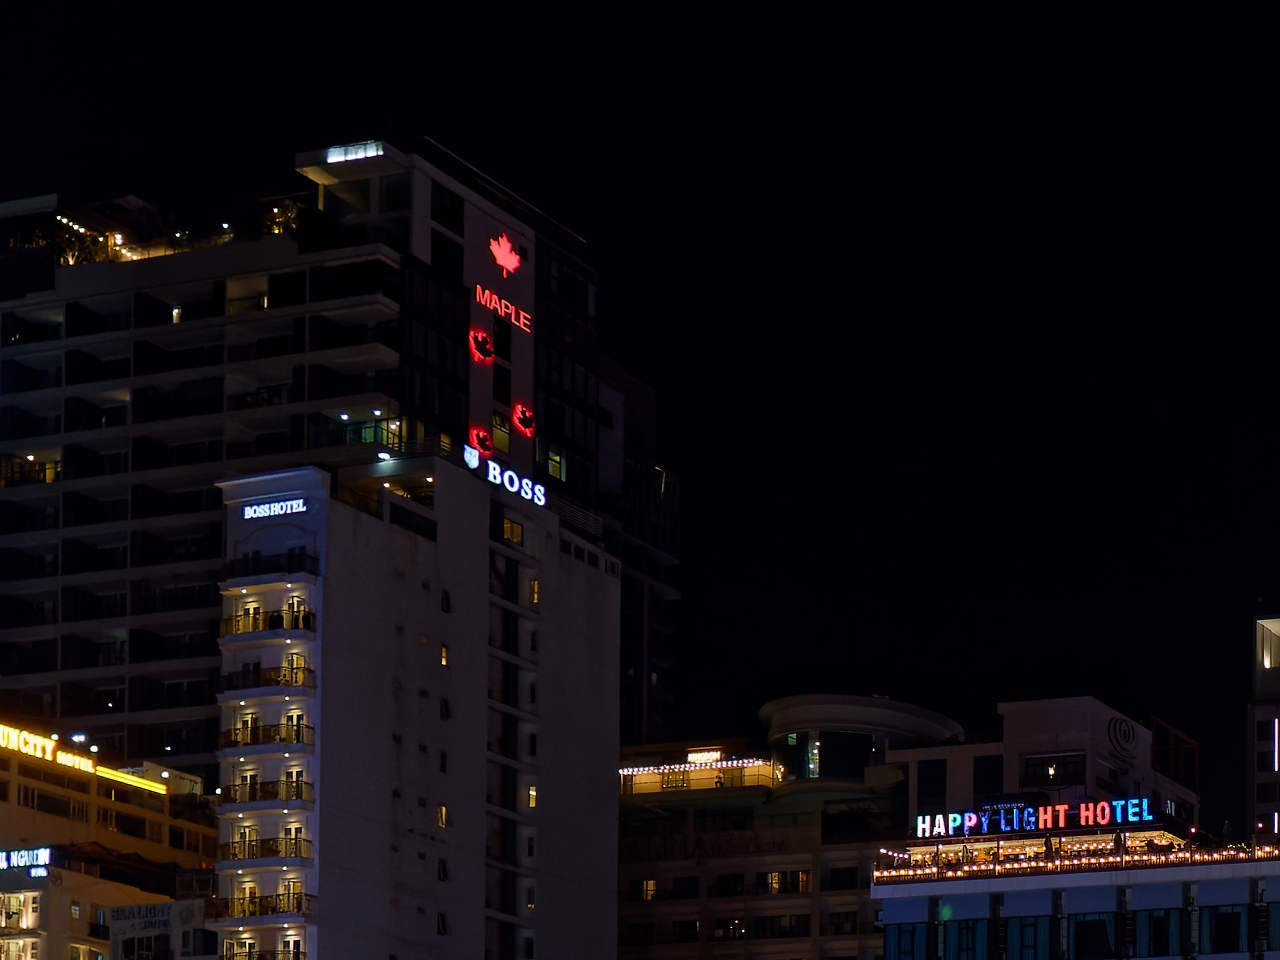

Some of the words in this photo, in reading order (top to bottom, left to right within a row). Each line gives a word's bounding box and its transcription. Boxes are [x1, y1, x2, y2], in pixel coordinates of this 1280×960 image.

[476, 284, 531, 333] MAPLE
[487, 460, 546, 506] BOSS
[244, 504, 270, 519] BOSS
[270, 499, 307, 516] HOTEL
[56, 750, 96, 773] HOTEL
[917, 812, 991, 838] HAPPY
[1000, 804, 1069, 831] LIGHT
[1079, 798, 1153, 825] HOTEL
